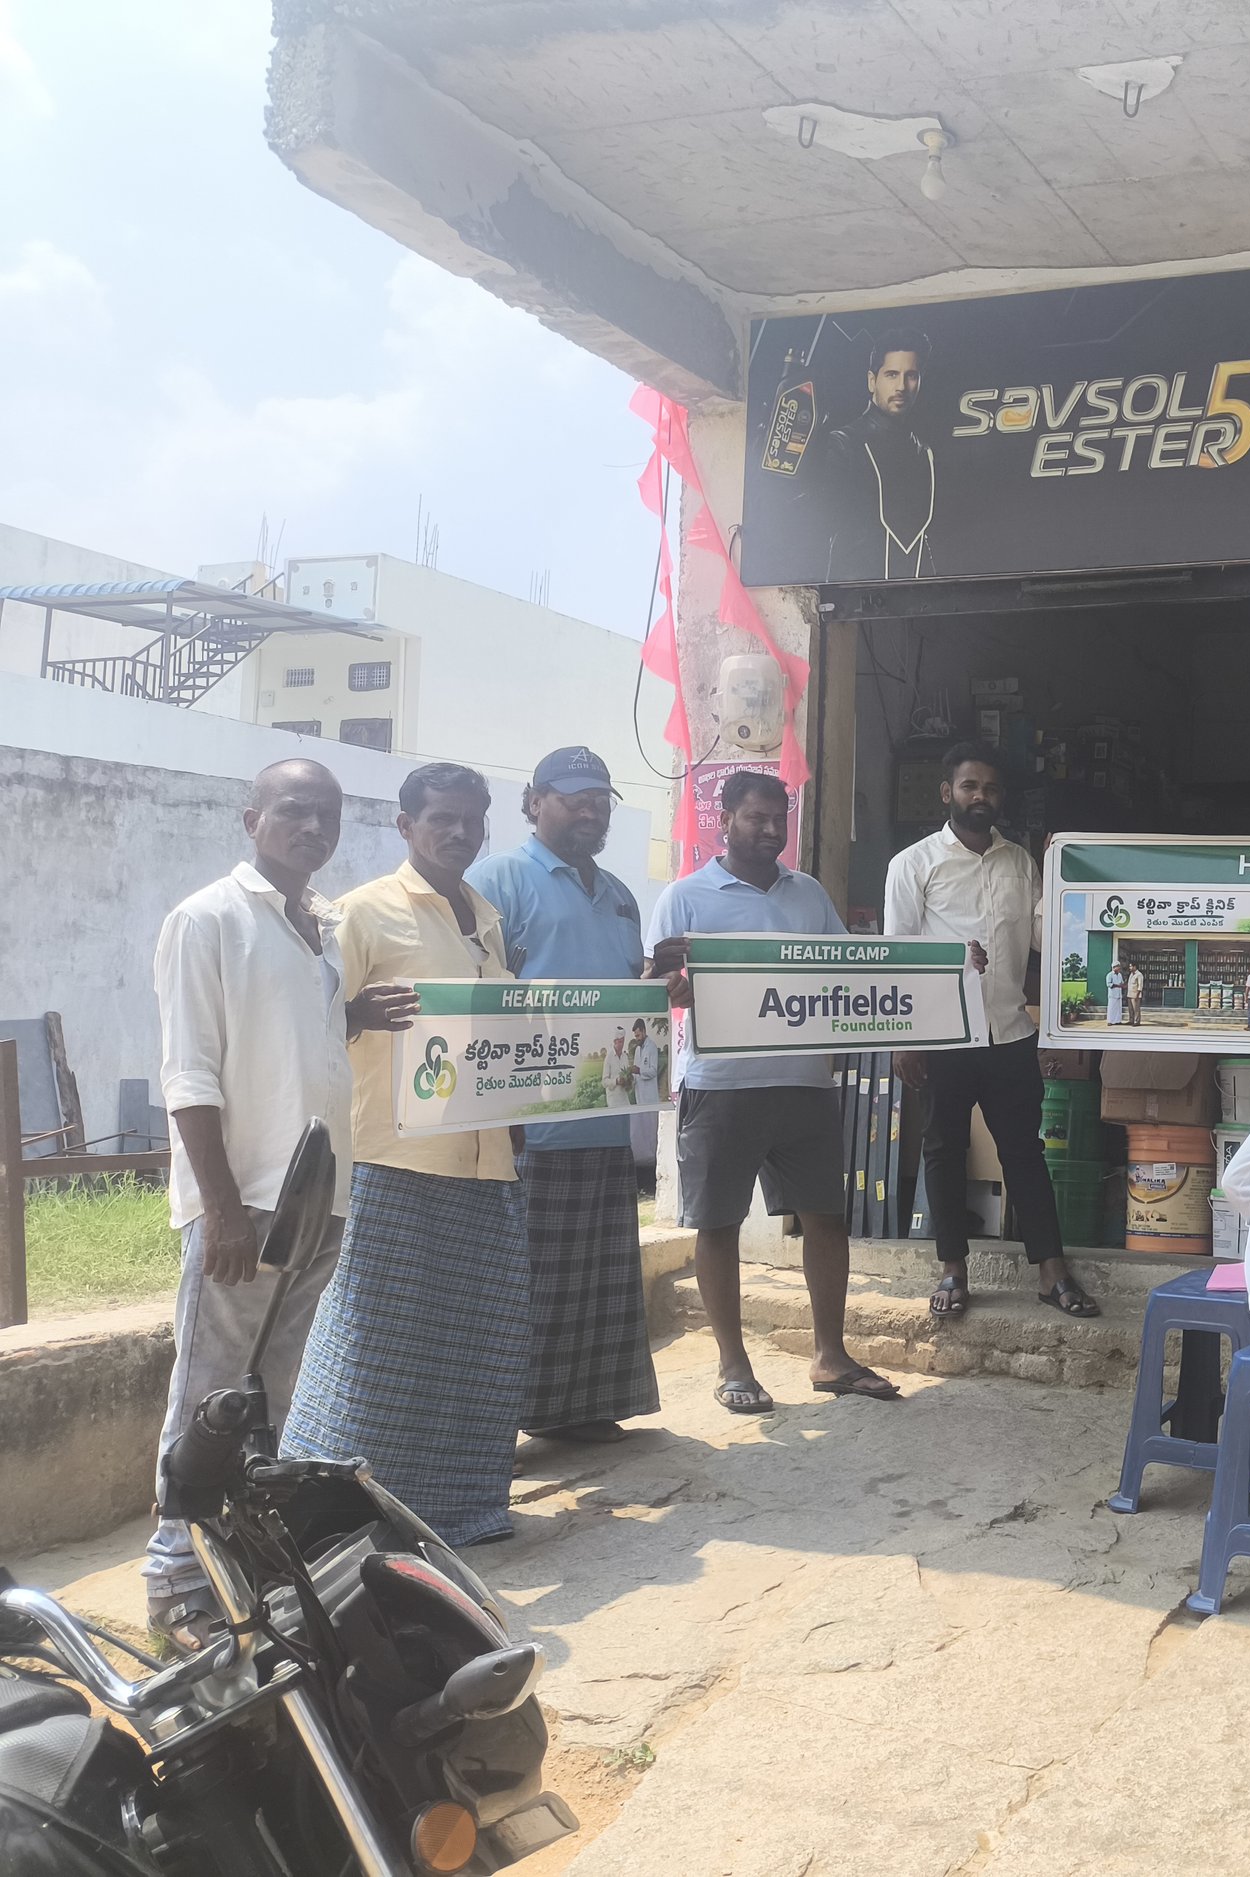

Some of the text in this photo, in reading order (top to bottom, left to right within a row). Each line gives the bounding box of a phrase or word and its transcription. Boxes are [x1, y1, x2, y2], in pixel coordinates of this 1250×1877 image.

[1030, 419, 1240, 478] ESTER
[780, 945, 890, 961] HEALTH CAMP
[502, 990, 601, 1008] HEALTH CAMP
[758, 985, 913, 1027] Agrifields
[831, 1015, 912, 1032] Foundation
[514, 1034, 544, 1065] క్రాప్
[548, 1033, 580, 1065] క్లినిక్
[476, 1072, 572, 1096] రైతుల మొదటి ఎంపిక
